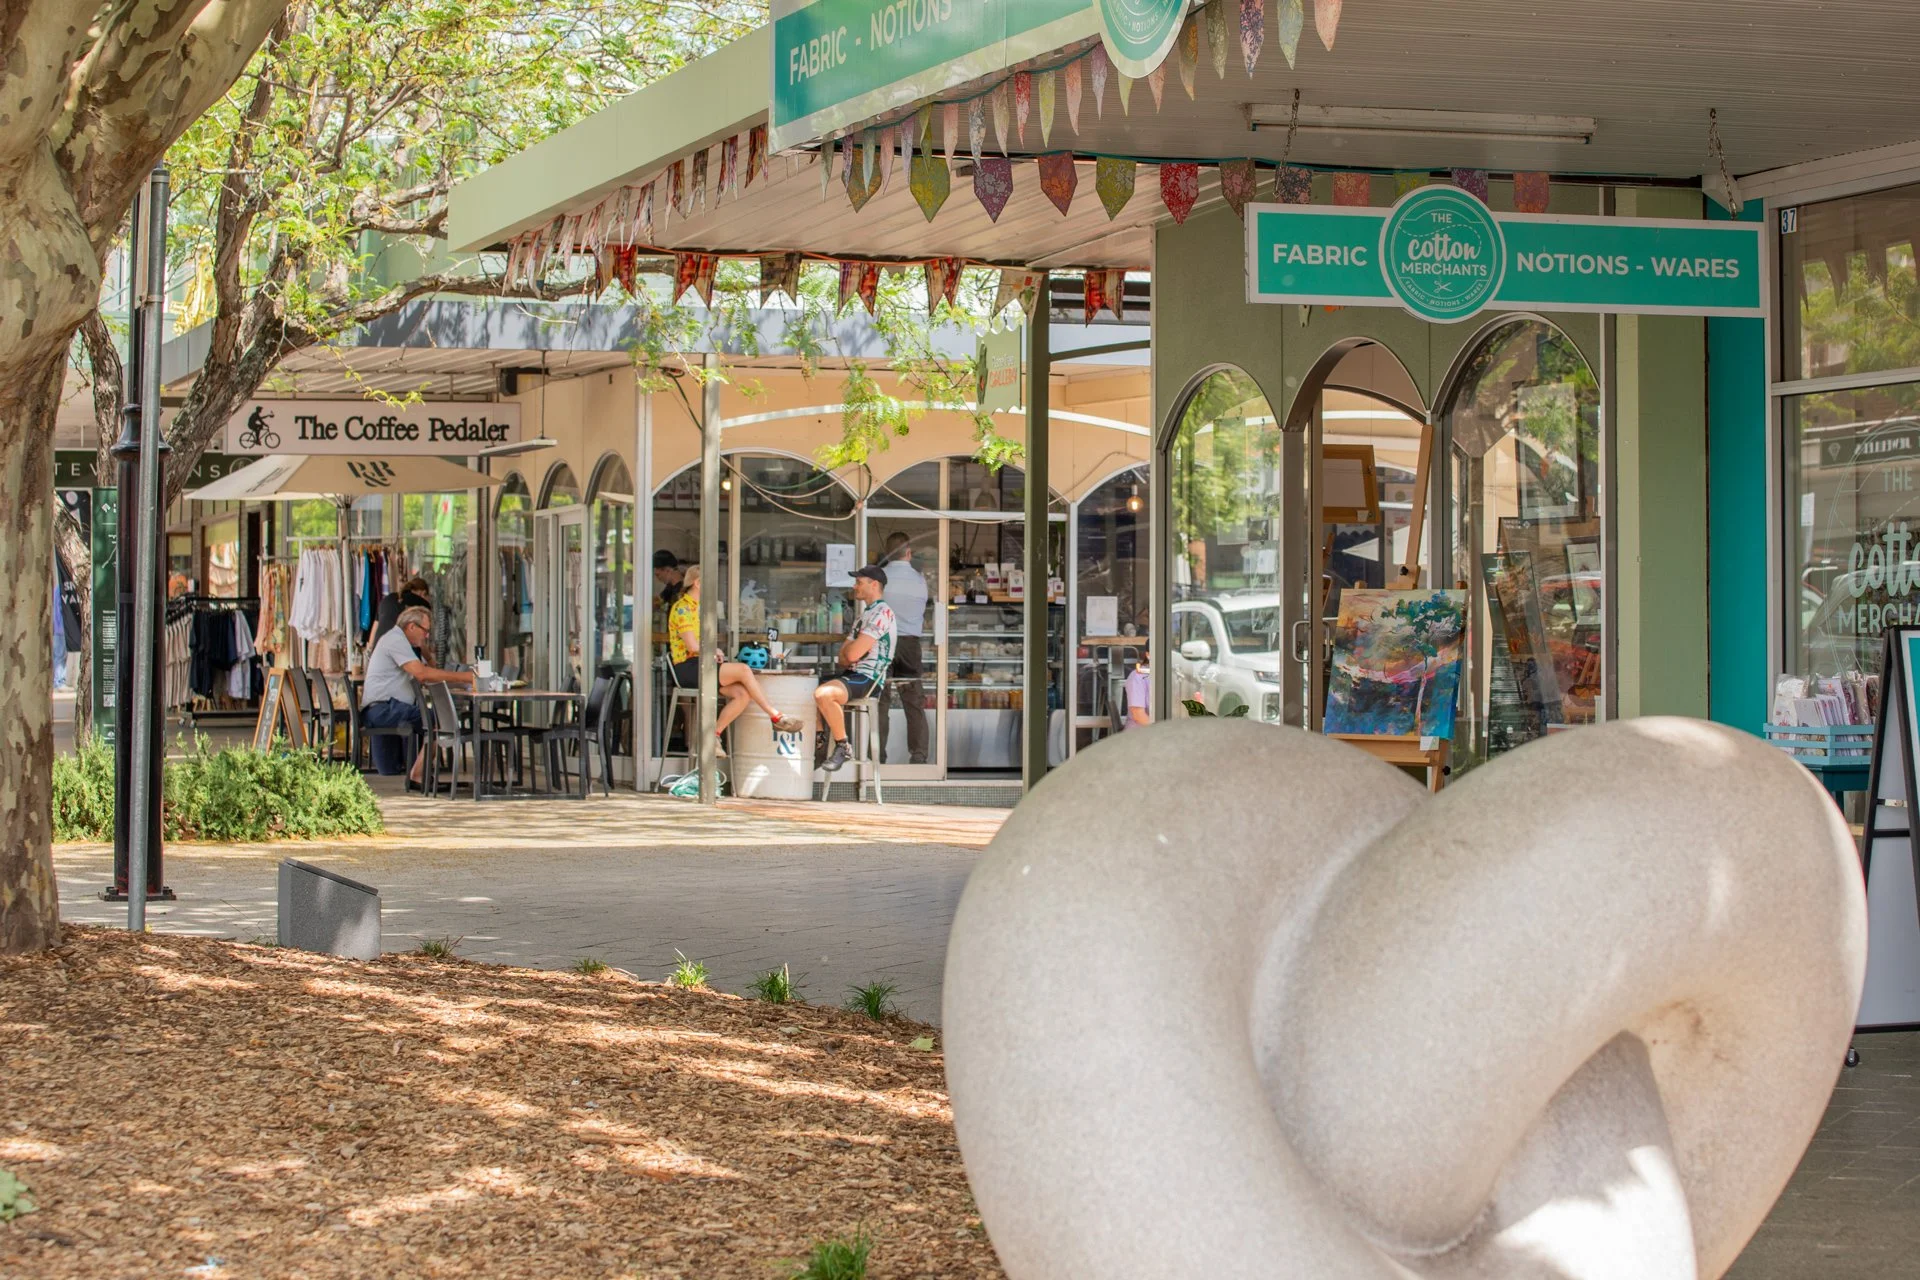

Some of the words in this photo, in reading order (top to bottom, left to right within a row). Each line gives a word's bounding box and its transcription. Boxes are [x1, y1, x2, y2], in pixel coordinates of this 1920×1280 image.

[789, 25, 848, 86] FABRIC
[870, 0, 952, 51] NOTIONS
[1430, 212, 1453, 224] THE
[1782, 209, 1796, 233] 37
[1272, 243, 1368, 267] FABRIC
[1408, 232, 1482, 262] cotton
[1400, 261, 1488, 278] MERCHANTS
[1516, 251, 1629, 276] NOTIONS
[1650, 256, 1740, 279] WARES
[1404, 280, 1426, 301] FABRIC
[1428, 298, 1461, 308] NOTIONS
[1464, 283, 1484, 301] WARES
[294, 415, 338, 440] The
[344, 416, 420, 441] Coffee
[428, 416, 510, 442] Pedaler
[1883, 466, 1913, 492] THE
